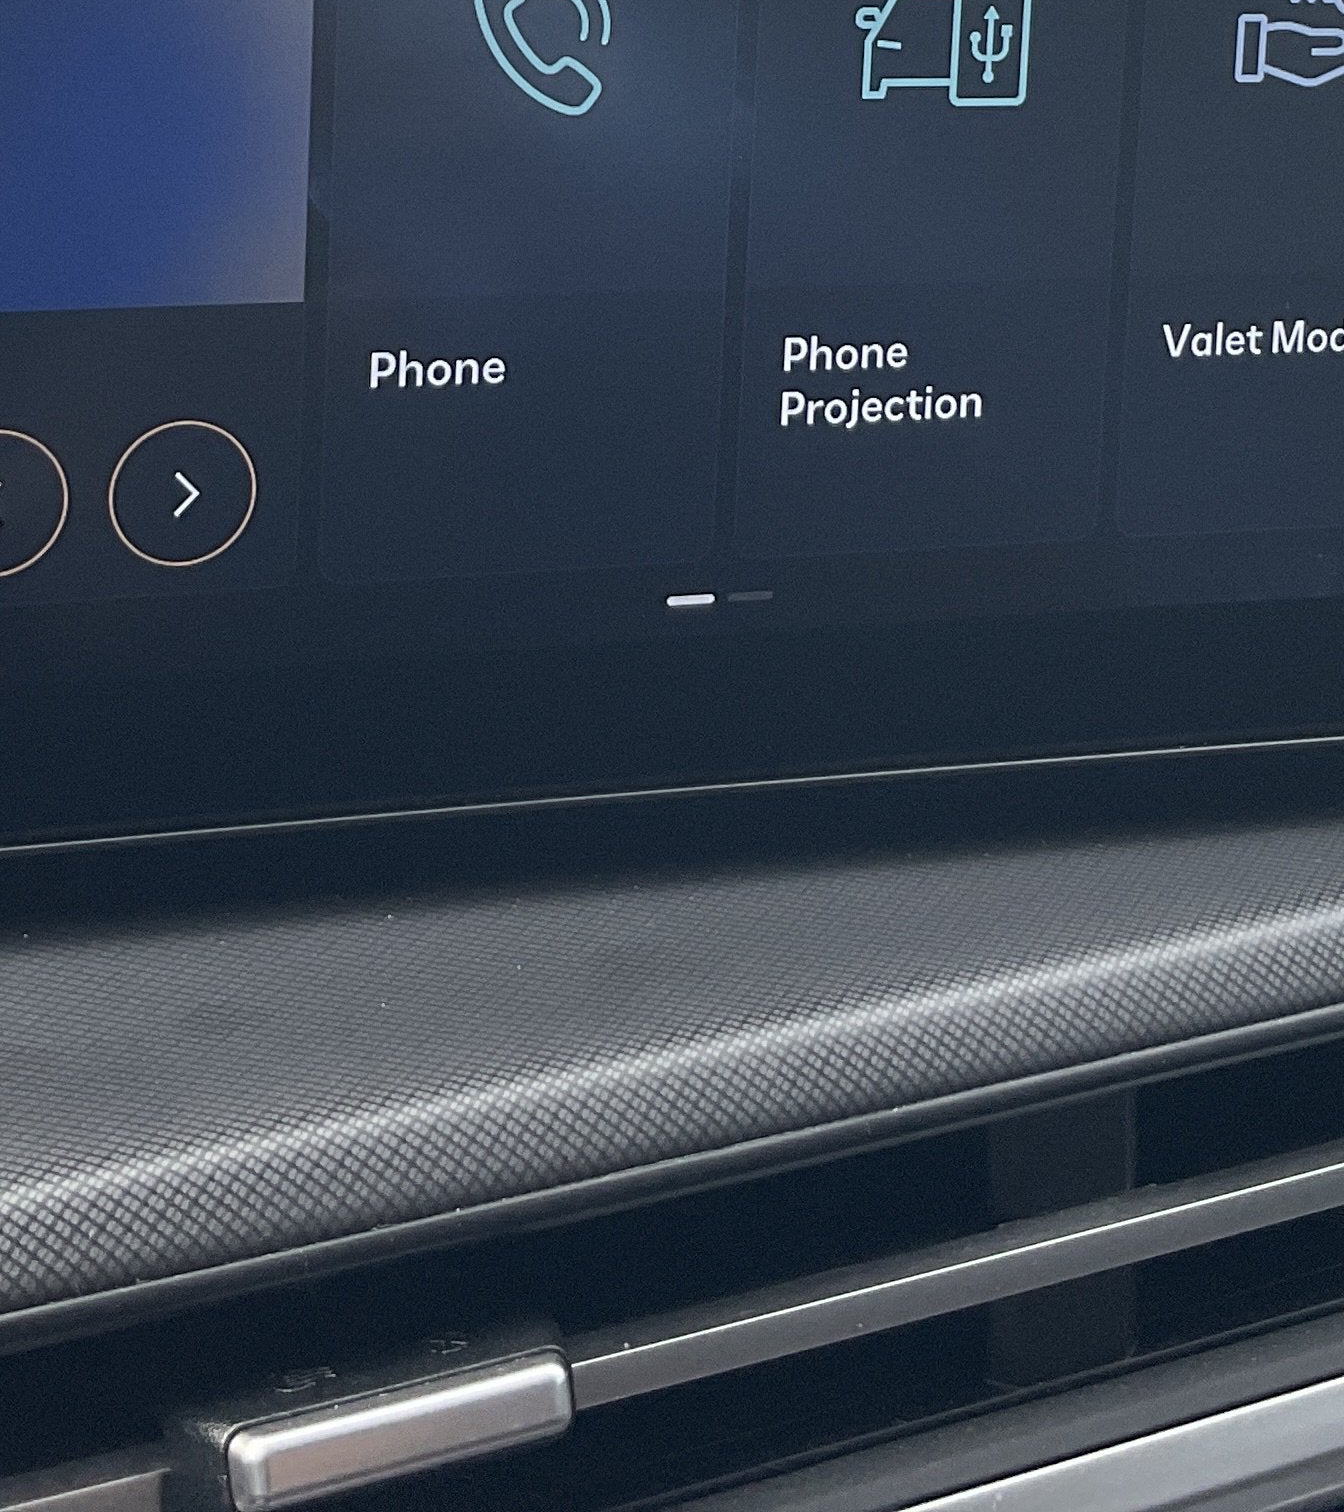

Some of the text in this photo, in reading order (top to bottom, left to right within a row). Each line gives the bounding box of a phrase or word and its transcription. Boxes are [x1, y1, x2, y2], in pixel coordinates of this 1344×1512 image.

[782, 334, 909, 374] Phone
[1161, 320, 1264, 359] Valet
[368, 349, 507, 390] Phone
[779, 384, 983, 430] Projection
